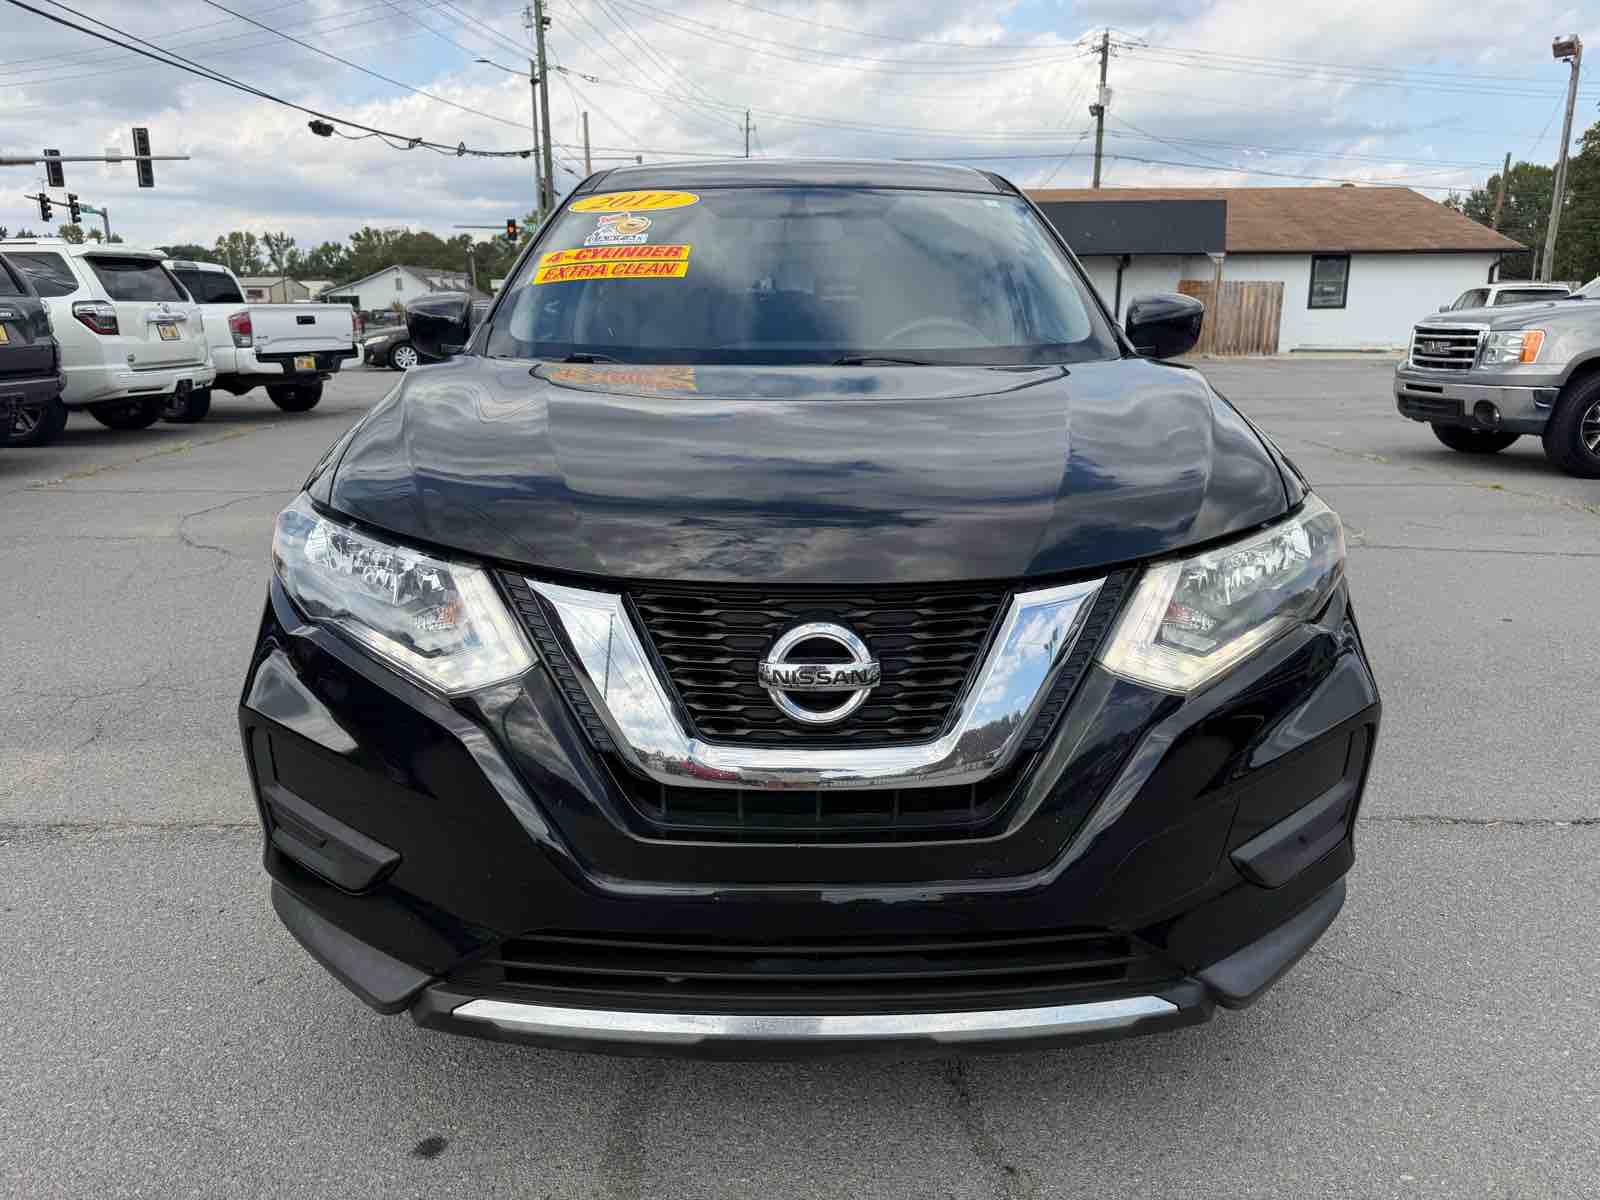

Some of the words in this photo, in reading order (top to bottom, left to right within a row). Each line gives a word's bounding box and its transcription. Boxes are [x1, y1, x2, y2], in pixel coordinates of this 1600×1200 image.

[588, 193, 680, 209] 2017
[546, 246, 682, 264] 4-CYLINDER
[542, 265, 606, 281] EXTRA
[611, 263, 677, 276] CLEAN
[772, 669, 867, 685] NISSAN
